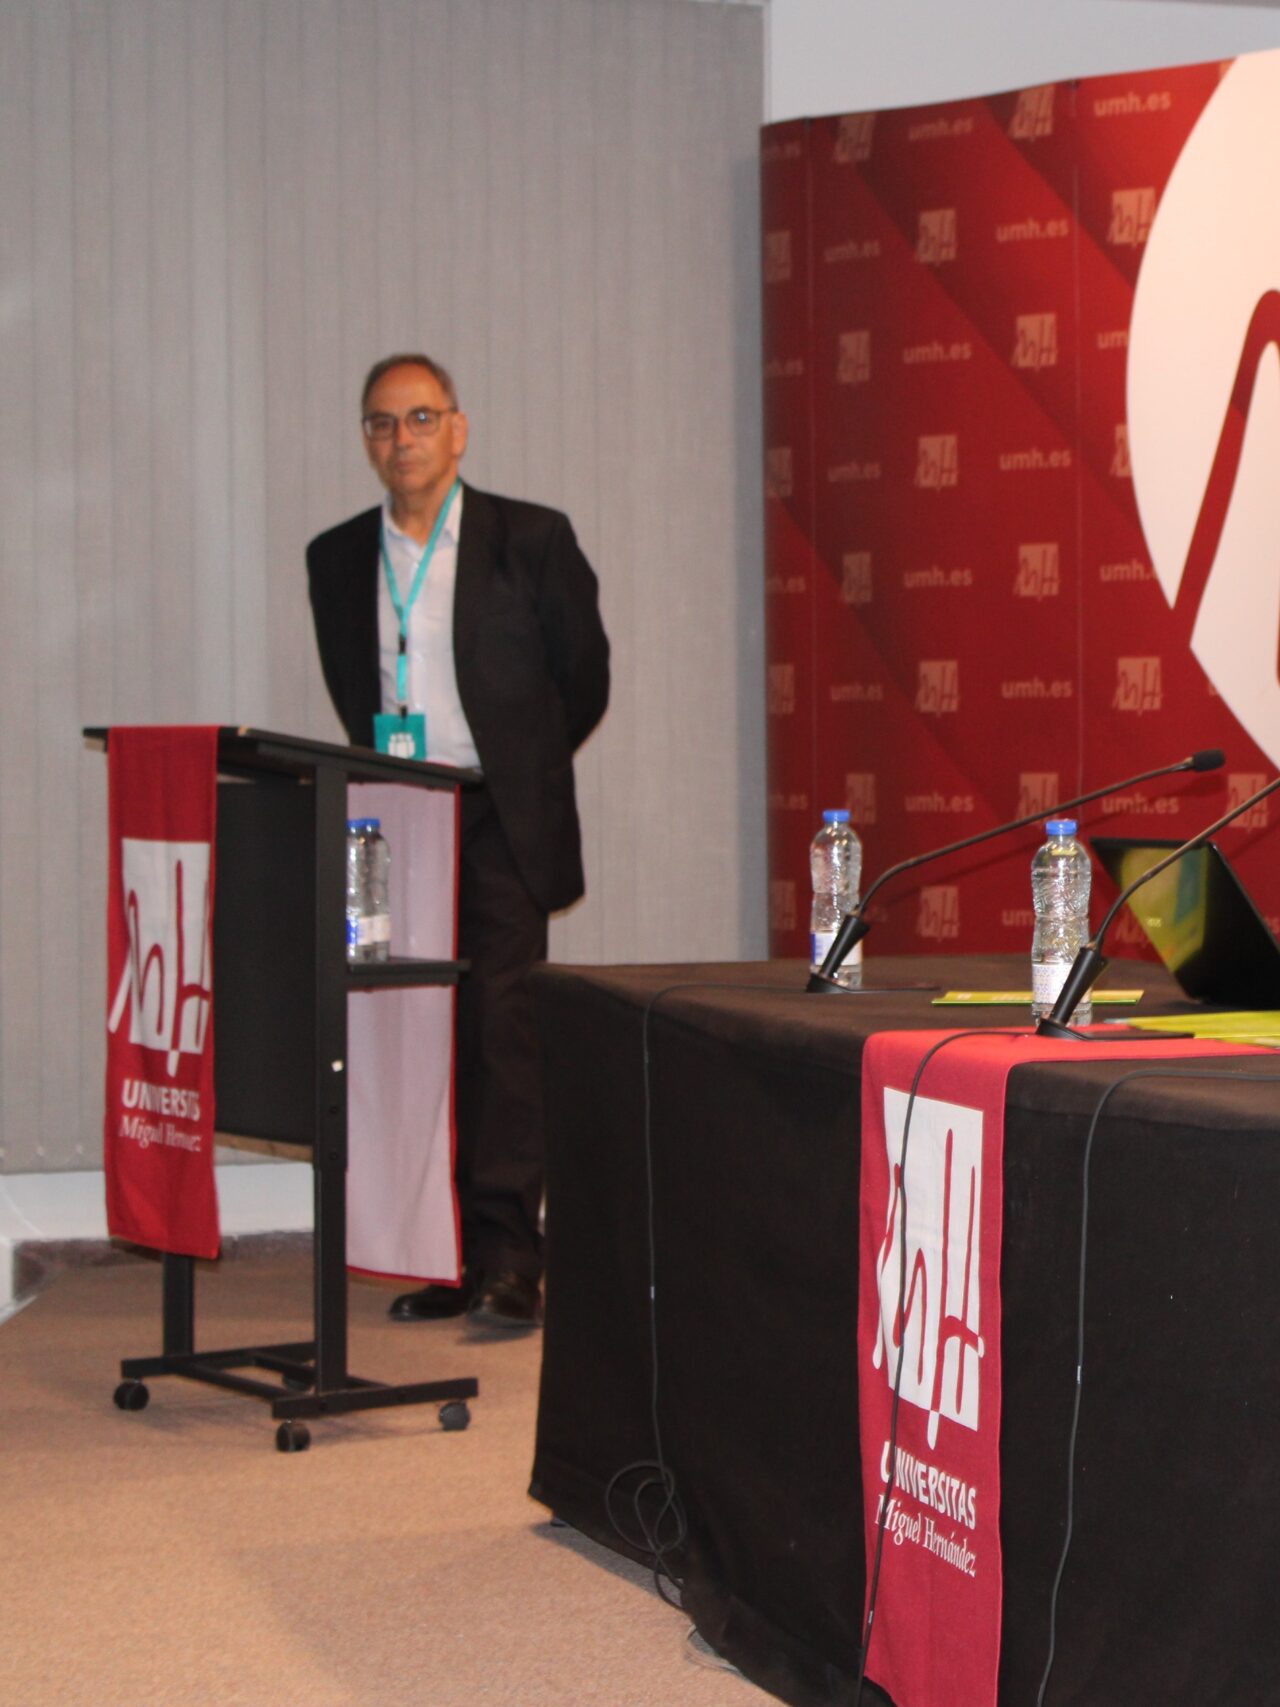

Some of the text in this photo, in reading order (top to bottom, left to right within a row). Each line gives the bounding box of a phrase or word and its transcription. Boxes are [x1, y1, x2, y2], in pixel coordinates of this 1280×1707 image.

[1094, 92, 1171, 117] umh.es
[909, 118, 973, 141] umh.es
[996, 217, 1069, 243] umh.es
[903, 340, 972, 364] umh.es
[1000, 449, 1071, 471] umh.es
[904, 566, 973, 588] umh.es
[1100, 559, 1158, 582] umh.
[1002, 678, 1072, 699] umh.es
[905, 792, 974, 813] umh.es
[1101, 793, 1179, 814] umh.es
[880, 1441, 976, 1530] UNIVERSITAS
[875, 1494, 976, 1578] Miguel Hernández
